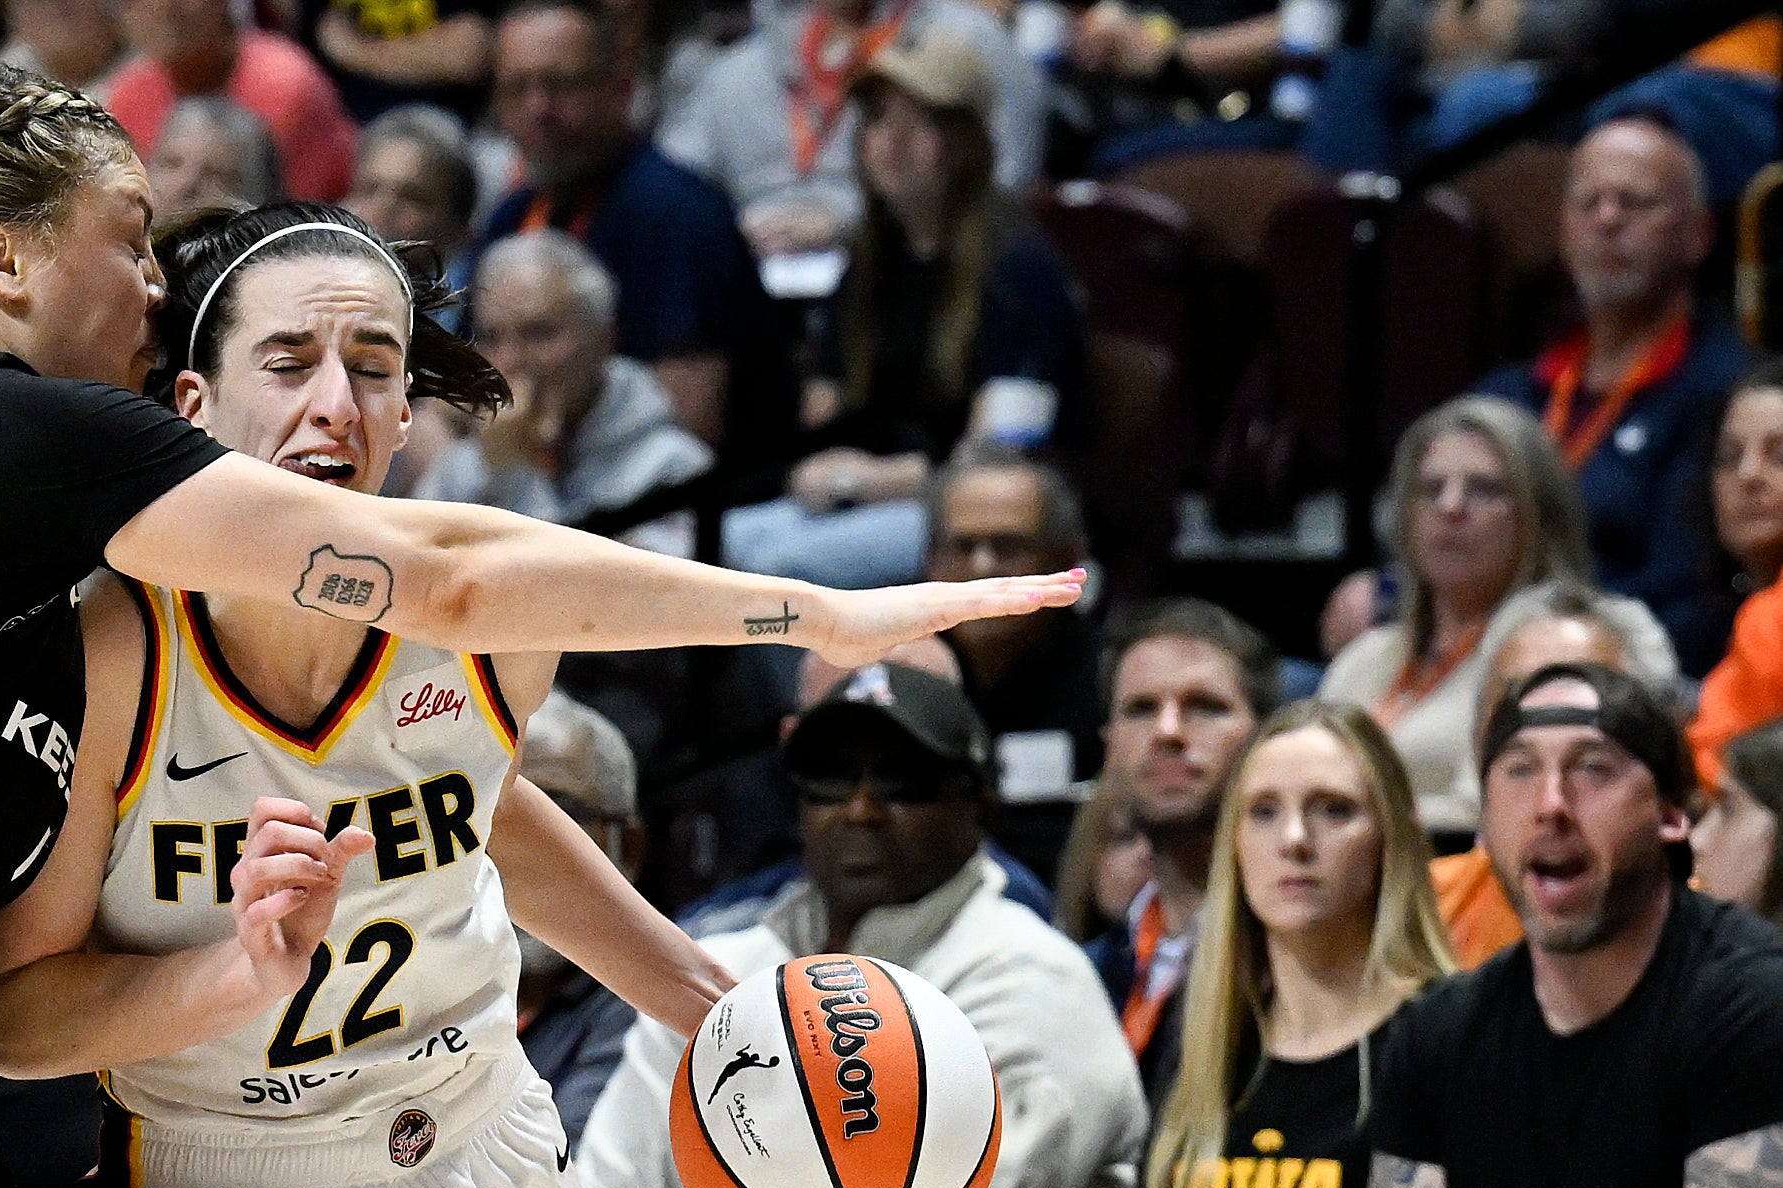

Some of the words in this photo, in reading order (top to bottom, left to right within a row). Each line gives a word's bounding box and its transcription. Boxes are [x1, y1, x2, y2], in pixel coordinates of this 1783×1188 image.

[396, 682, 467, 727] Lilly
[264, 917, 417, 1071] 22
[803, 1010, 815, 1034] EVO
[810, 1035, 823, 1058] NXT
[804, 959, 882, 1141] Wilson
